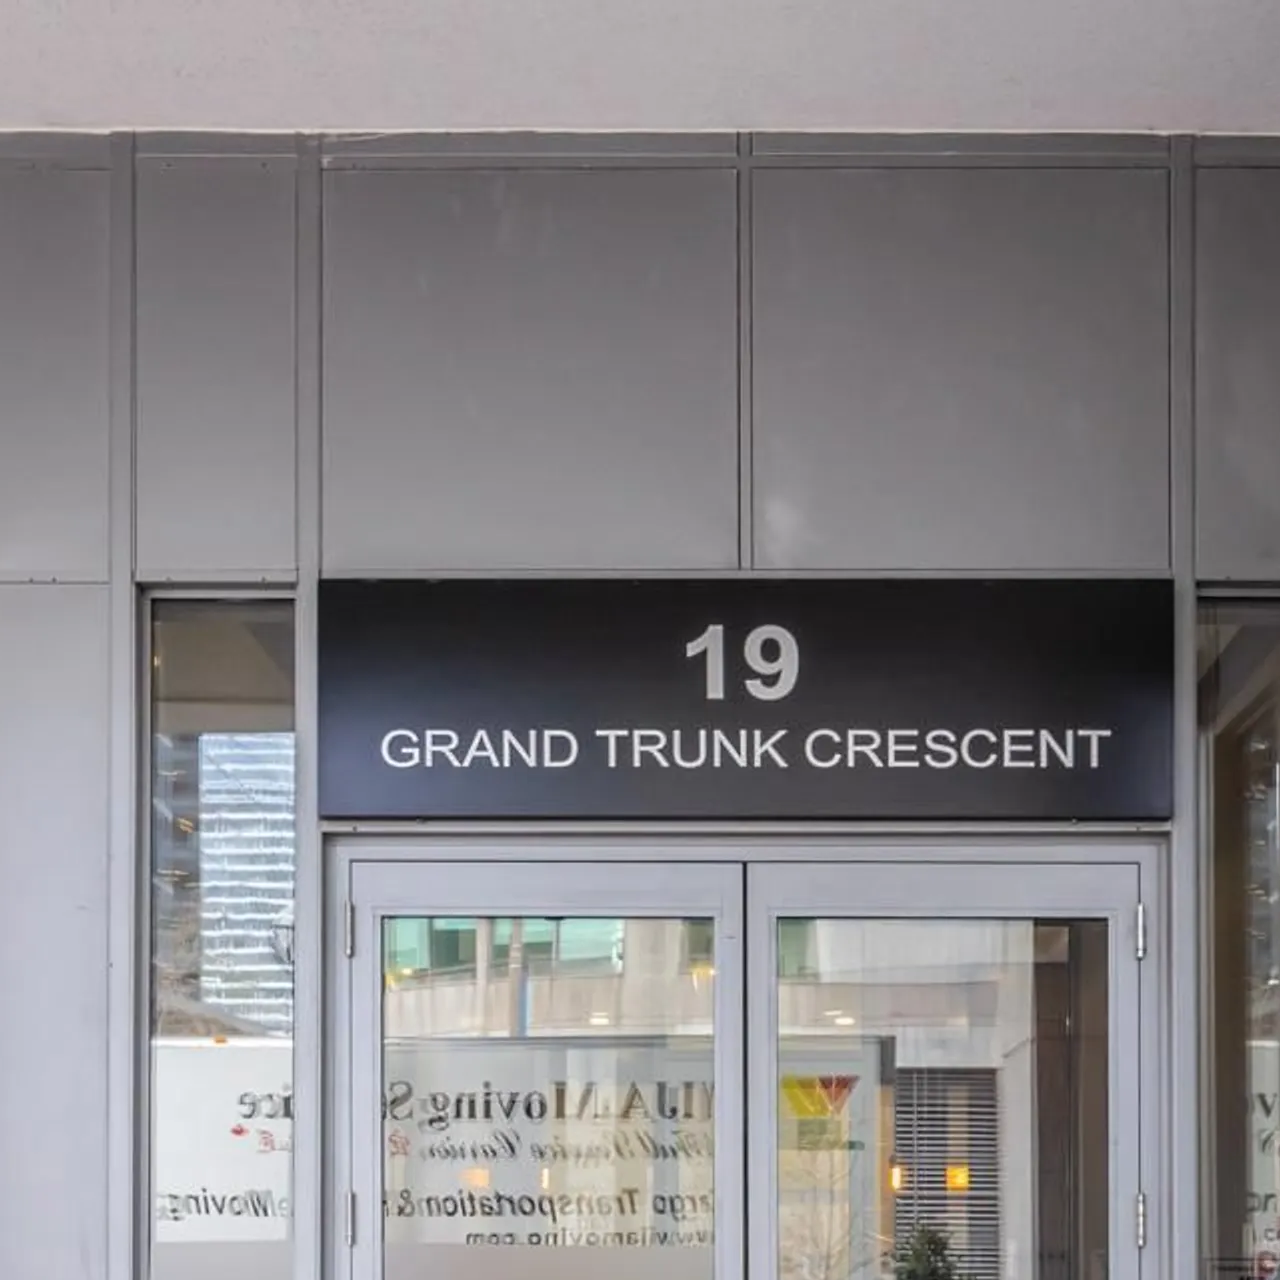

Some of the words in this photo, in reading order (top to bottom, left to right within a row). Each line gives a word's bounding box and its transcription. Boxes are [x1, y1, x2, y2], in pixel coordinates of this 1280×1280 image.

[685, 623, 800, 701] 19
[379, 728, 579, 769] GRAND
[594, 728, 789, 769] TRUNK
[804, 728, 1112, 769] CRESCENT
